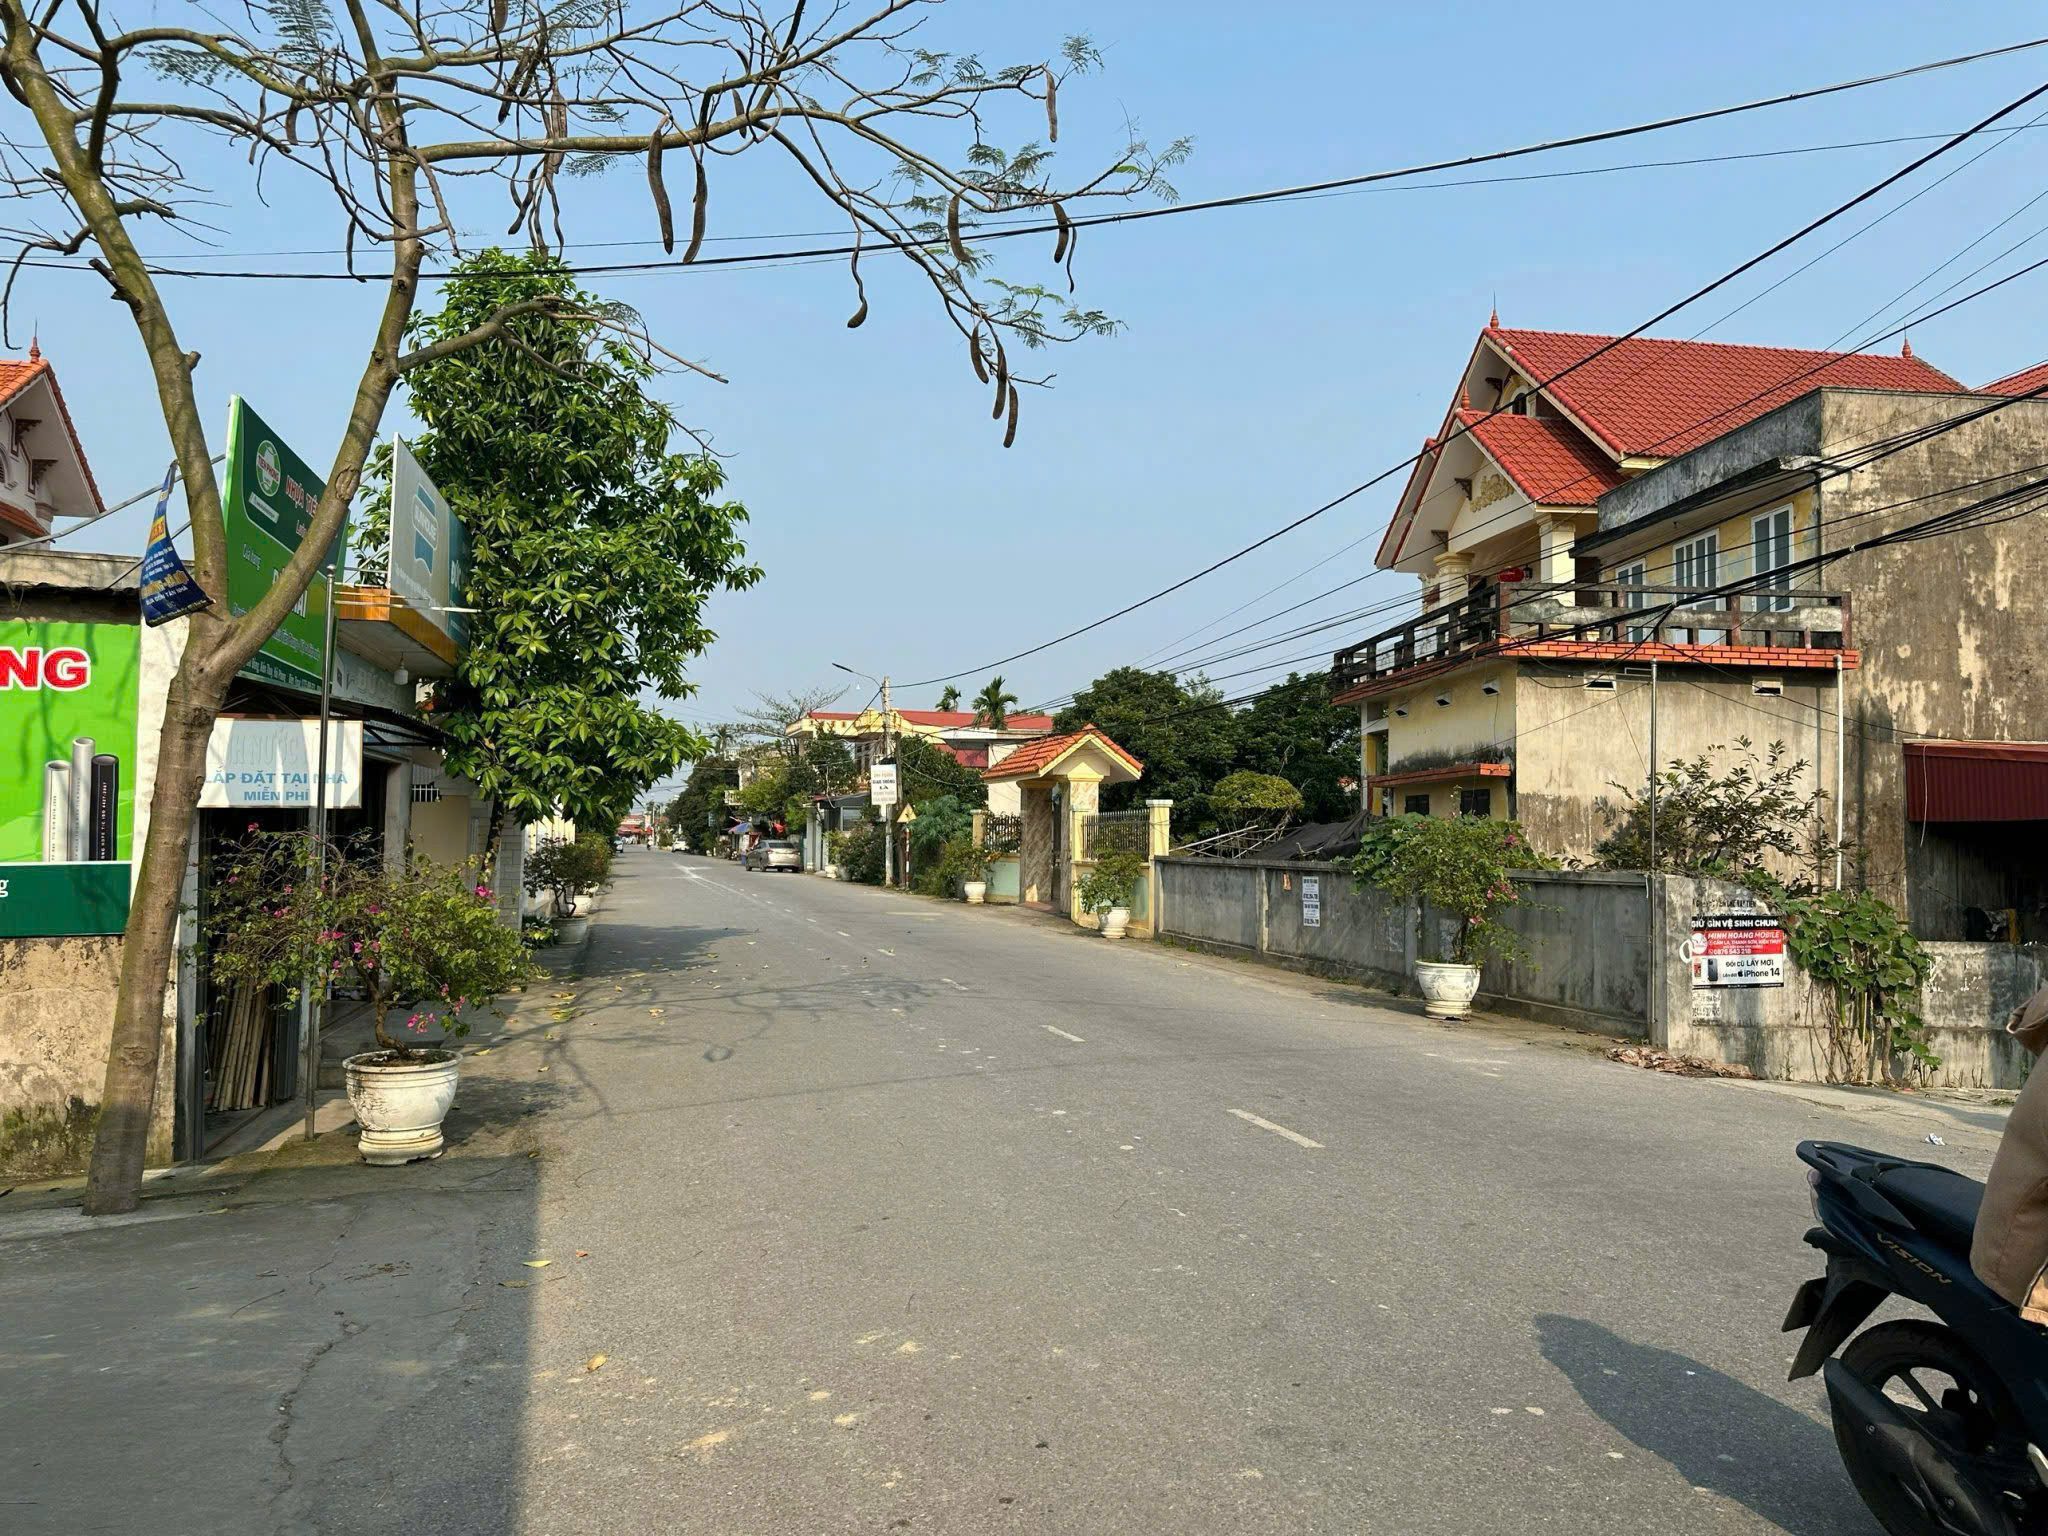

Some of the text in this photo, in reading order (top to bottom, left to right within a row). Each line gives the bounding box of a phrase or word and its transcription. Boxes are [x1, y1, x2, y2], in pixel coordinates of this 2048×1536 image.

[240, 769, 277, 787] ĐẶT
[281, 772, 309, 788] TẠI
[243, 786, 310, 802] MIỄN PHÍ
[1707, 918, 1721, 928] GÌN
[1721, 917, 1733, 930] VỆ
[1734, 919, 1753, 928] SINH
[1754, 918, 1778, 928] CHUN
[1708, 931, 1727, 939] MINH
[1754, 930, 1780, 939] MOBILE
[1744, 969, 1769, 978] iPhone
[1770, 967, 1781, 977] 14
[1876, 1232, 1953, 1284] VISION
